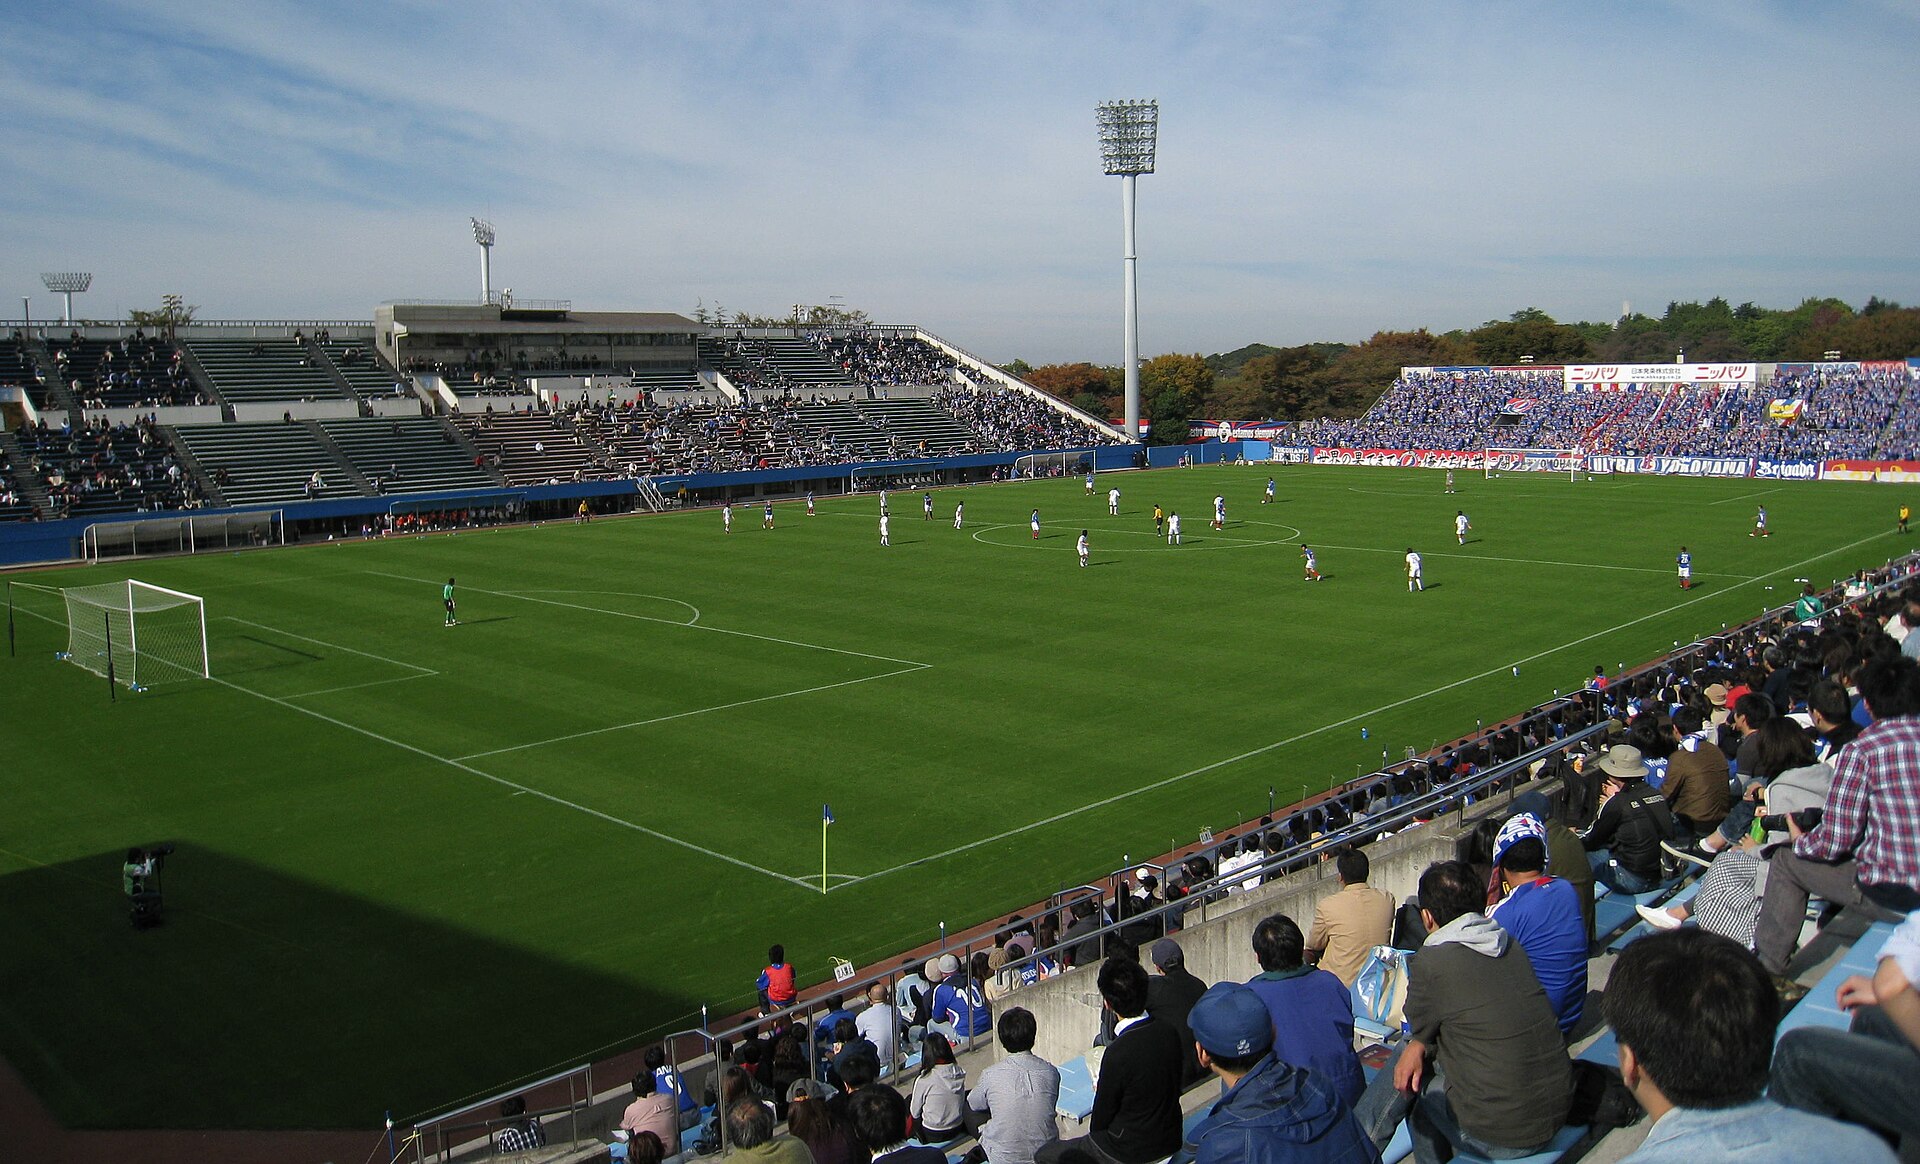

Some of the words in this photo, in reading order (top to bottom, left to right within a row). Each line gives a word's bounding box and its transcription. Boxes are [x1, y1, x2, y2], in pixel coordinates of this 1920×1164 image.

[1571, 367, 1618, 380] ニッパツ
[1695, 366, 1747, 379] ニッパツ
[1273, 452, 1301, 462] HEDS
[1593, 457, 1635, 472] ULTRA
[956, 984, 983, 1007] 10
